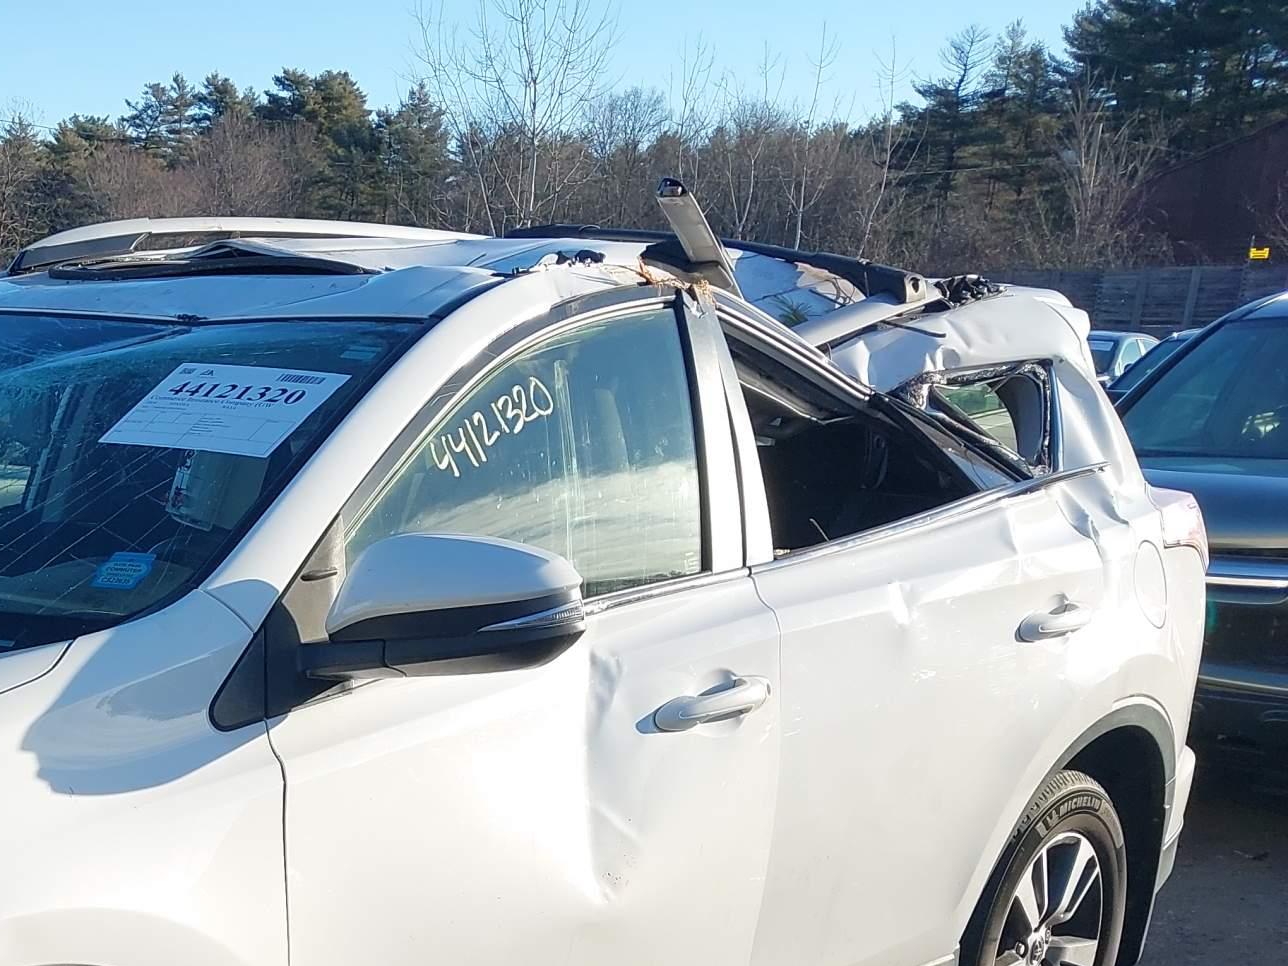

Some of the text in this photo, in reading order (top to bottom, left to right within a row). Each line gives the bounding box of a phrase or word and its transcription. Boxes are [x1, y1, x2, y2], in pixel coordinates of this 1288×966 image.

[168, 380, 307, 405] 44121320
[429, 376, 554, 478] 44121320
[1059, 796, 1101, 817] MICHELIN
